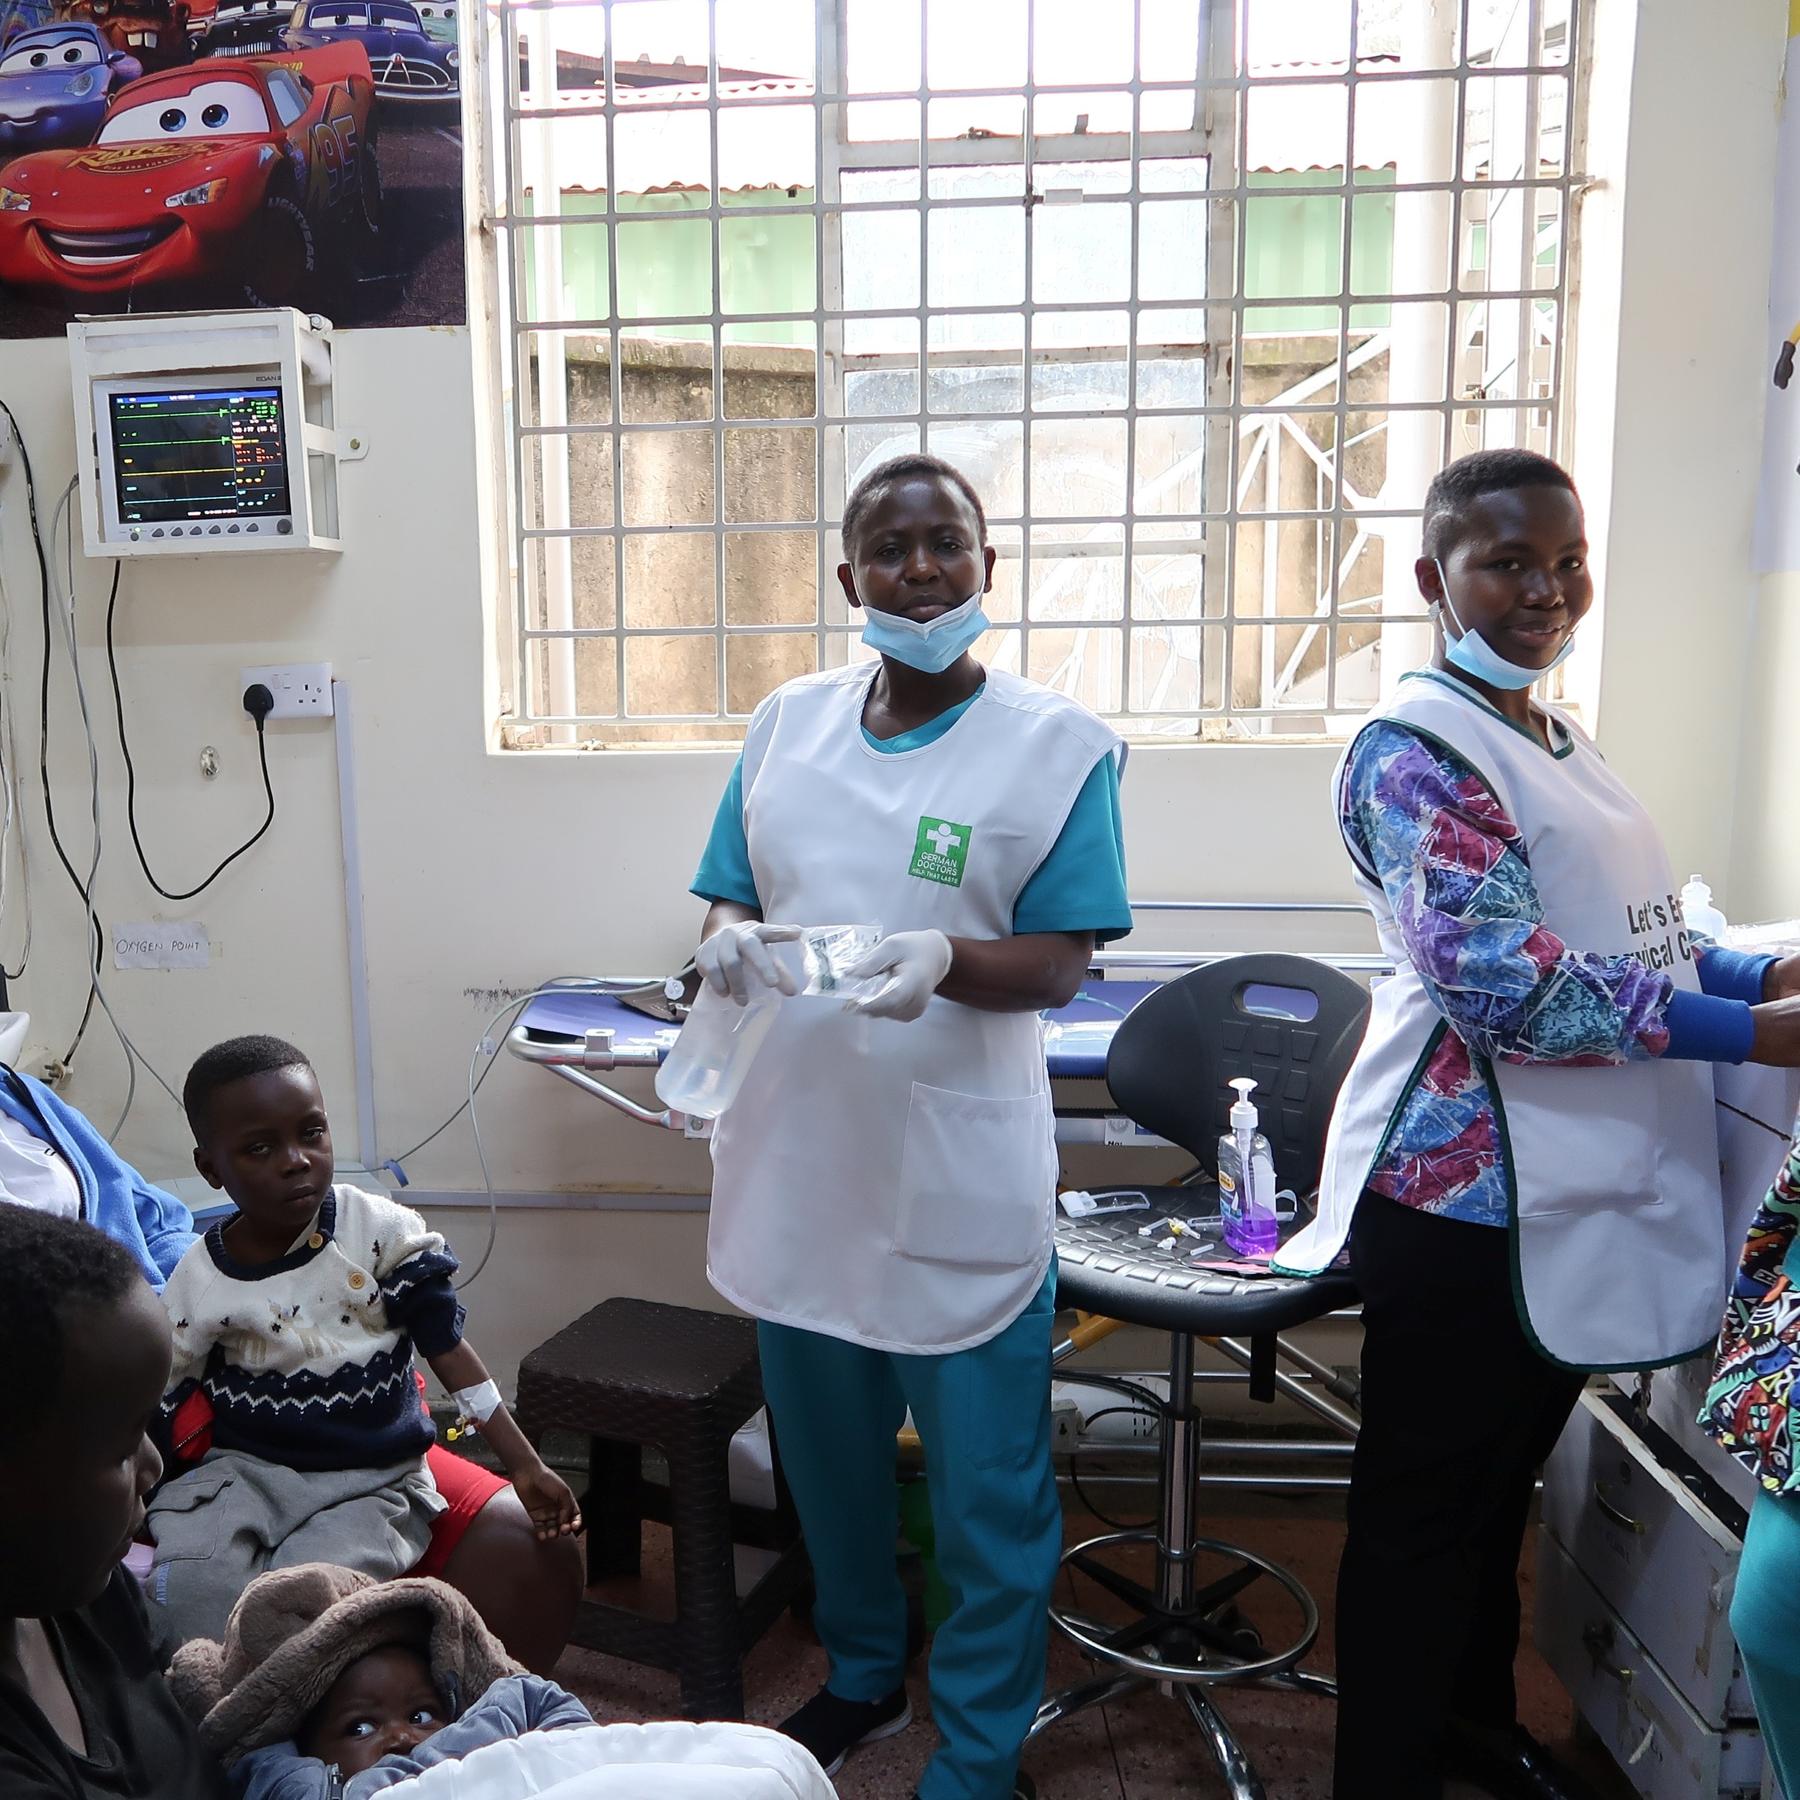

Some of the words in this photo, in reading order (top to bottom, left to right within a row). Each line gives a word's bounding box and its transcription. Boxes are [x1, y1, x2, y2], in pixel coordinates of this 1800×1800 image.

[314, 115, 359, 190] 95
[917, 860, 957, 876] DOCTORS
[921, 852, 957, 867] GERMAN
[1627, 901, 1667, 934] Let's
[116, 939, 162, 954] OXYGEN
[172, 941, 199, 952] POINT
[1677, 931, 1691, 961] C
